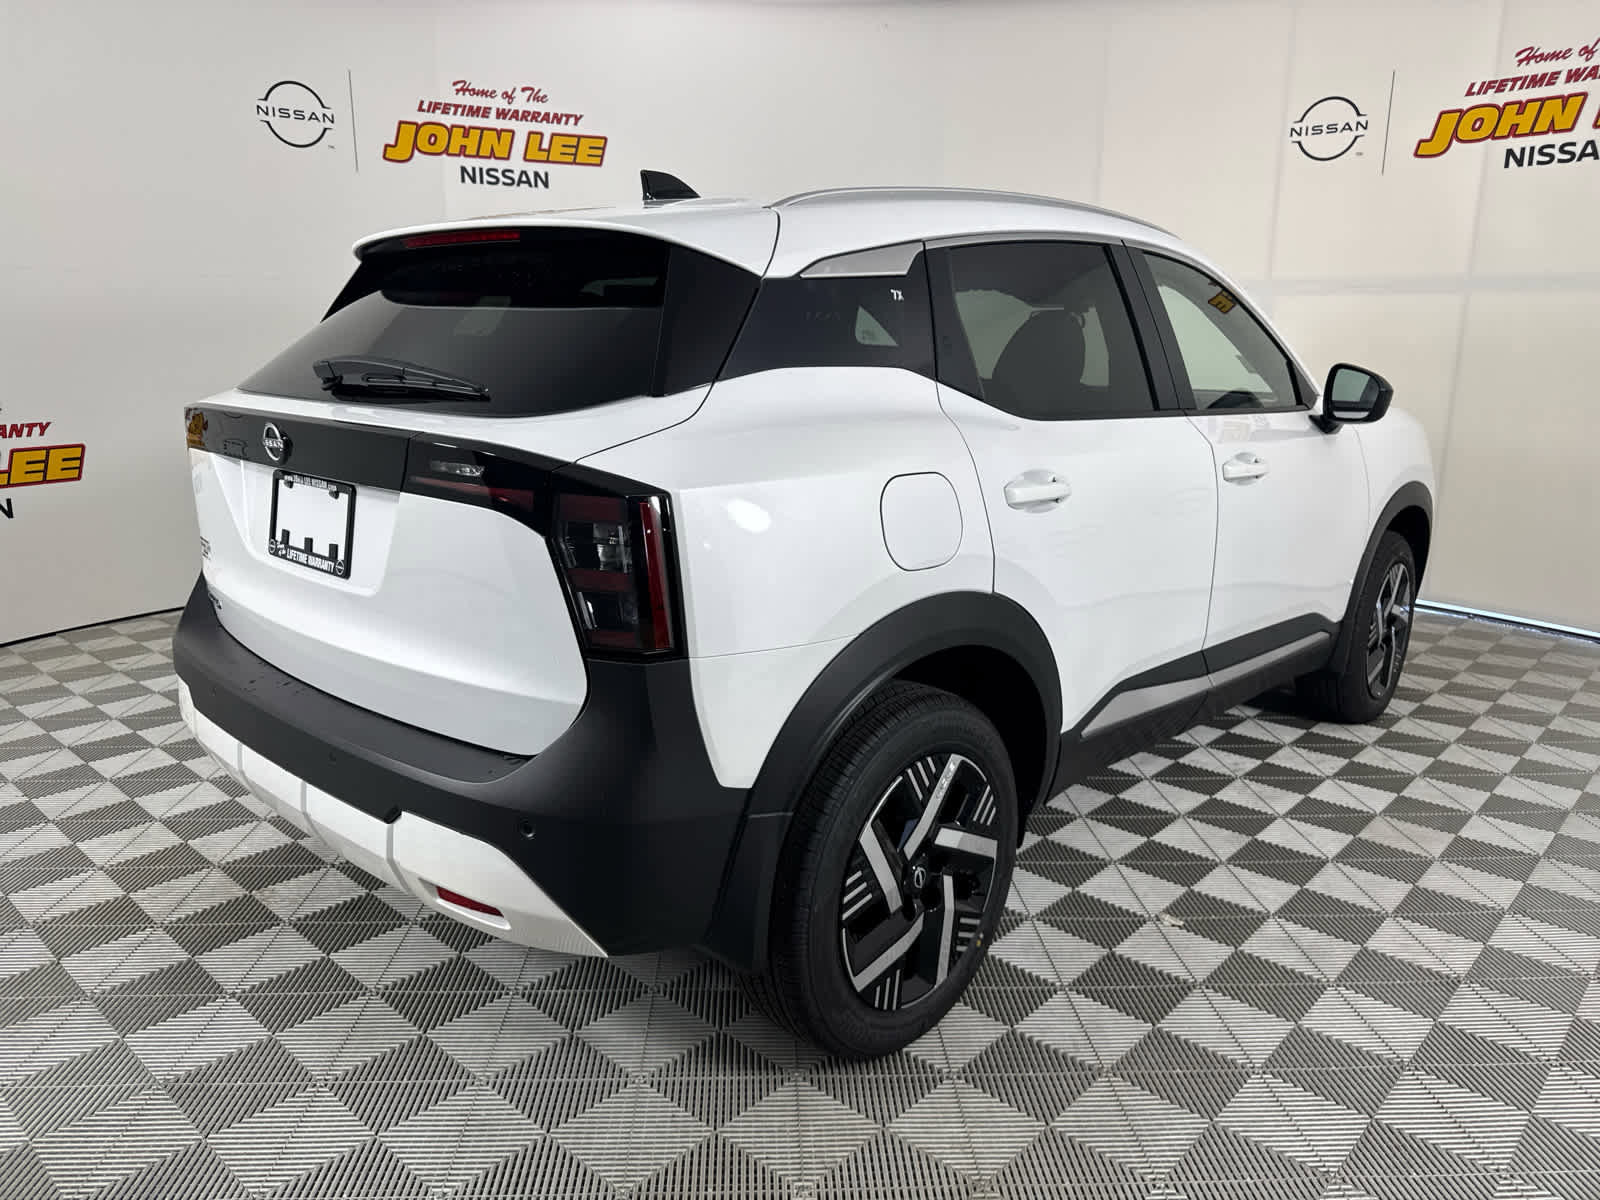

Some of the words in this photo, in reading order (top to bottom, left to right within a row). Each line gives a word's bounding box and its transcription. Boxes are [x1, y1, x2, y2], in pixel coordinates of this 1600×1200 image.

[1514, 46, 1573, 67] Home
[1578, 37, 1600, 62] of
[452, 80, 497, 99] Home
[501, 87, 516, 105] of
[520, 86, 549, 104] The
[1464, 70, 1562, 97] LIFETIME
[256, 104, 335, 124] NISSAN
[417, 100, 492, 119] LIFETIME
[495, 106, 584, 126] WARRANTY
[1413, 91, 1588, 158] JOHN
[1289, 119, 1368, 137] NISSAN
[382, 120, 515, 164] JOHN
[523, 130, 608, 167] LEE
[459, 165, 550, 189] NISSAN
[890, 289, 905, 301] TX
[286, 548, 308, 564] LIFETIME
[308, 555, 335, 573] WARRANTY
